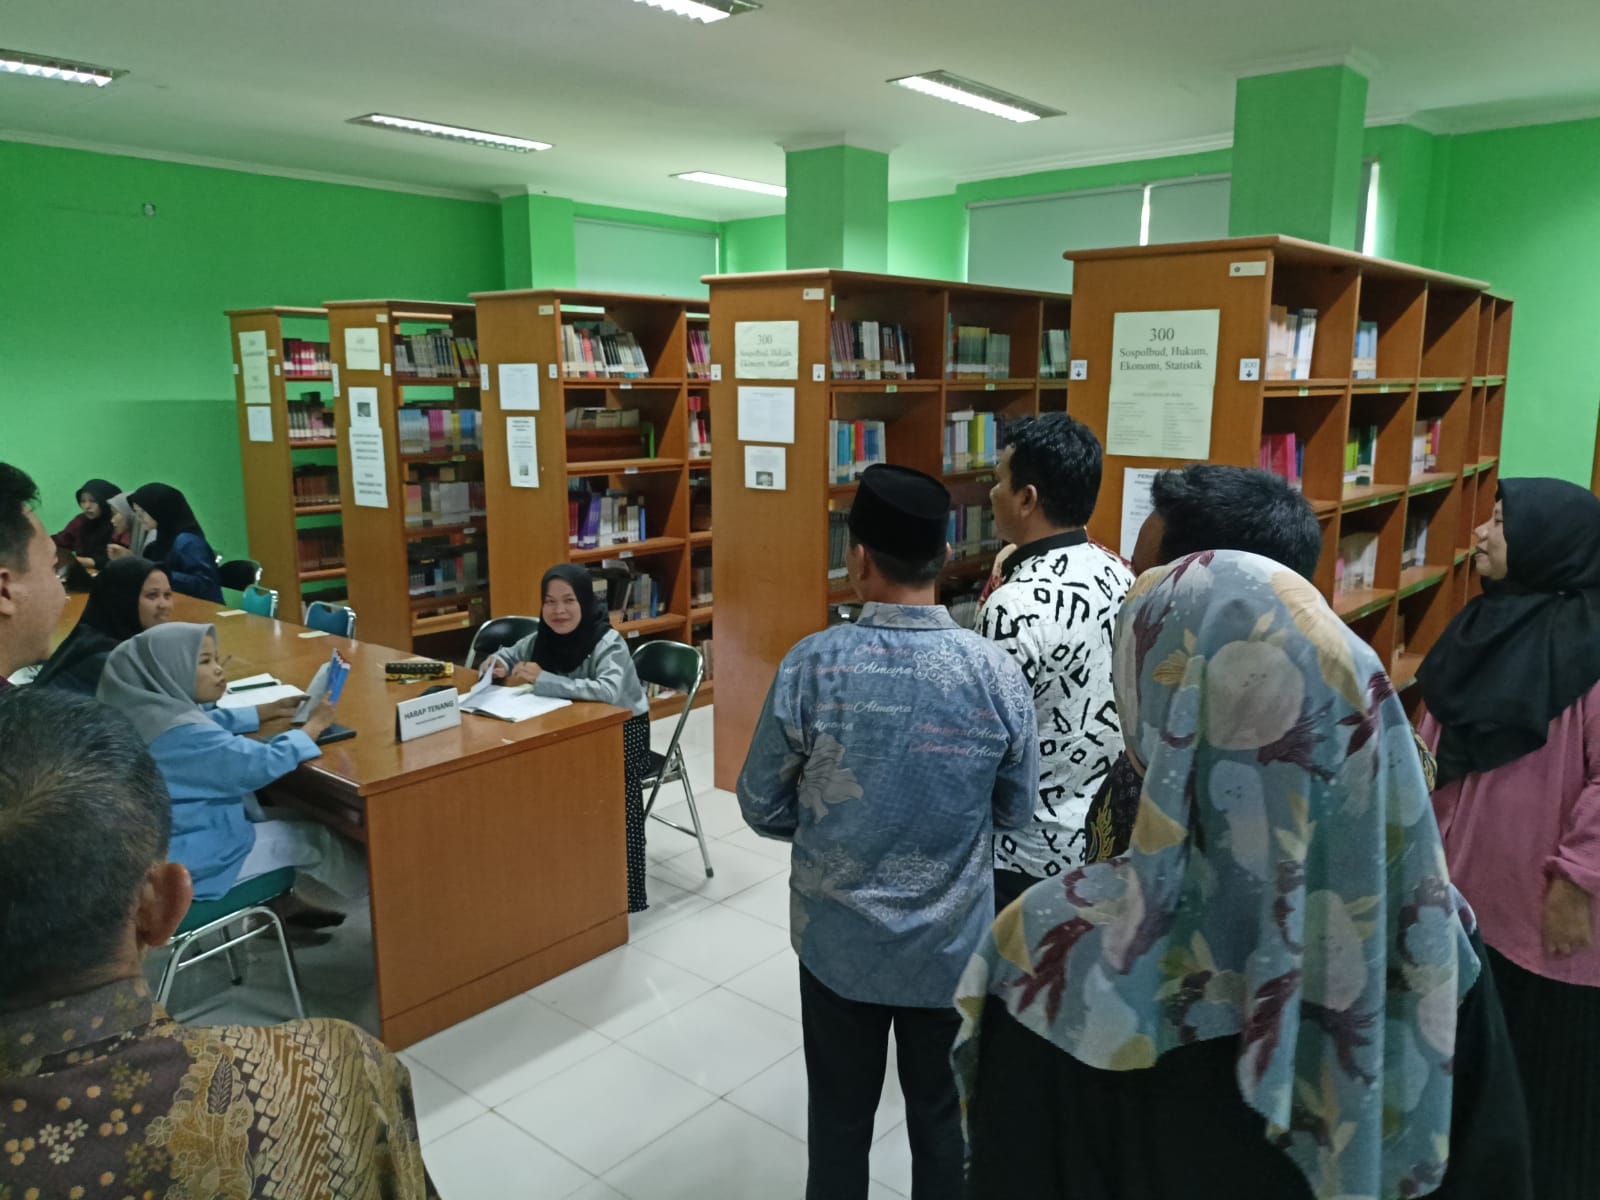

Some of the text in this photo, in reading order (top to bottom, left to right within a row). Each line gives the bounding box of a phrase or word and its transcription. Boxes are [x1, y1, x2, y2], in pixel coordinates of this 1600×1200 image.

[1149, 327, 1175, 342] 300
[1119, 345, 1209, 359] Sospolbud, Hukum,
[1119, 360, 1203, 372] Ekonomi, Statistik
[404, 700, 454, 719] HARAP TENANG
